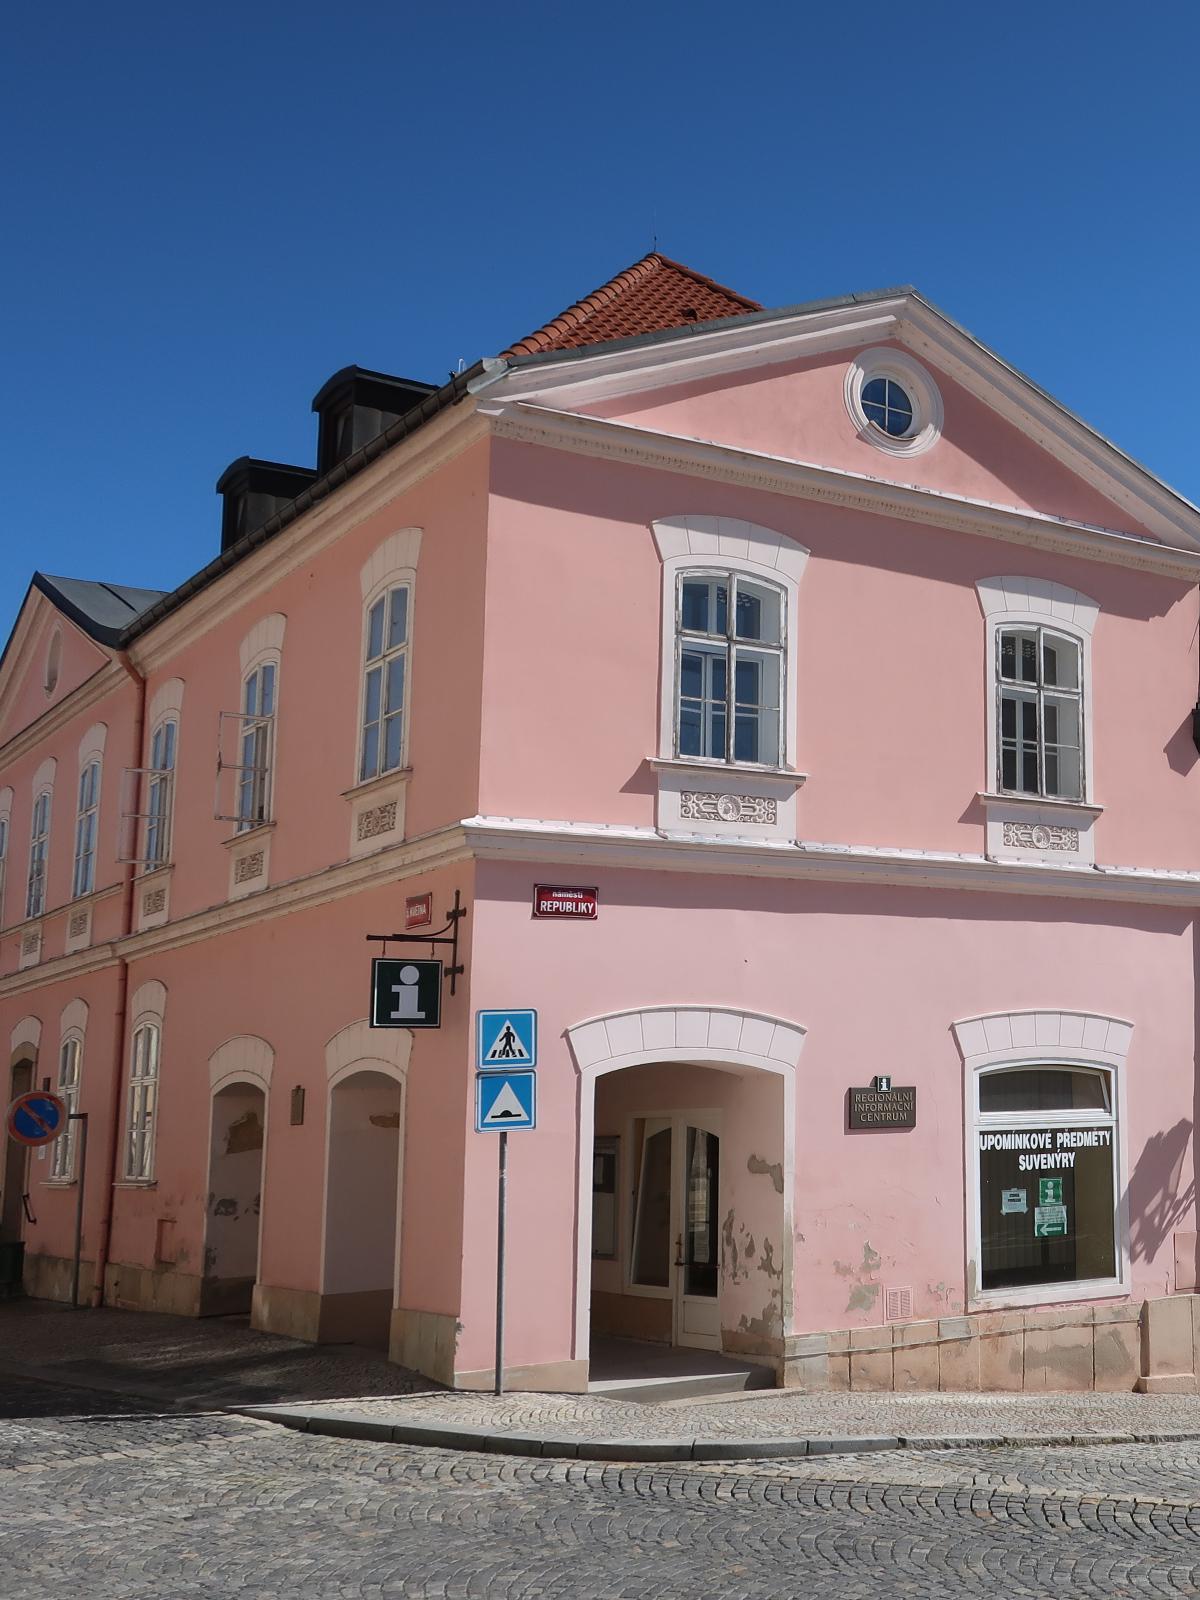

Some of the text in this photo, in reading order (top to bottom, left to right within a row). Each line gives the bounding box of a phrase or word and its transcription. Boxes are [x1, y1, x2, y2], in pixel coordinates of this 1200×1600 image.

[540, 900, 594, 914] REPUBLIKY
[855, 1092, 913, 1102] REGIONÁLNÍ
[854, 1102, 913, 1112] INFORMAČNÍ
[860, 1112, 907, 1122] CENTRUM
[980, 1128, 1111, 1151] UPOMÍNKOVÉ PŘEDMĚTY
[1018, 1149, 1076, 1172] SUVENÝRY
